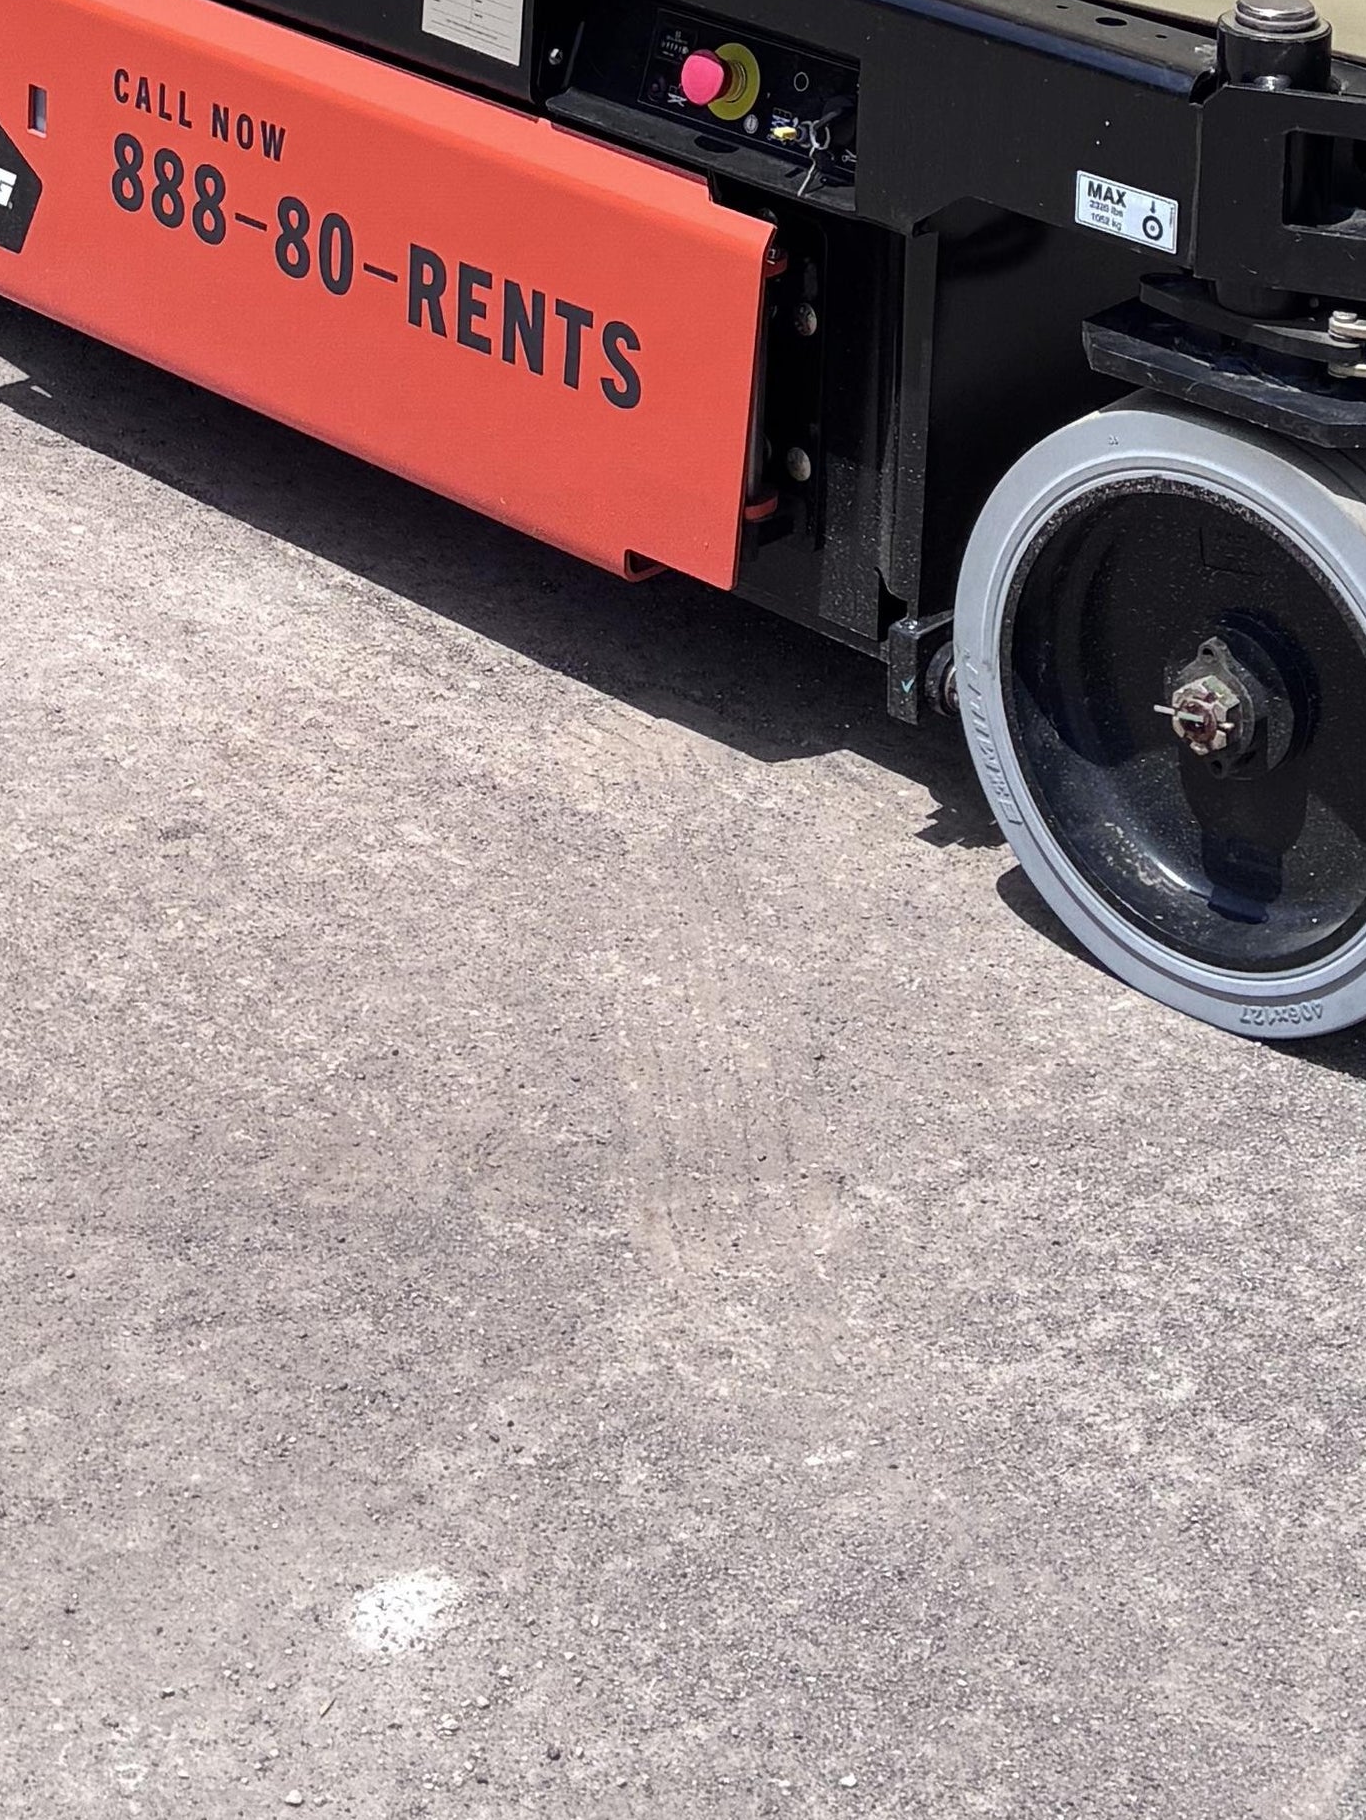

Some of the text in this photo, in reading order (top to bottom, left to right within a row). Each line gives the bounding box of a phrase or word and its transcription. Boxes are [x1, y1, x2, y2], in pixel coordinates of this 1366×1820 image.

[113, 67, 288, 163] CALL NOW
[1088, 181, 1127, 208] MAX
[111, 132, 643, 411] 888-80-RENTS
